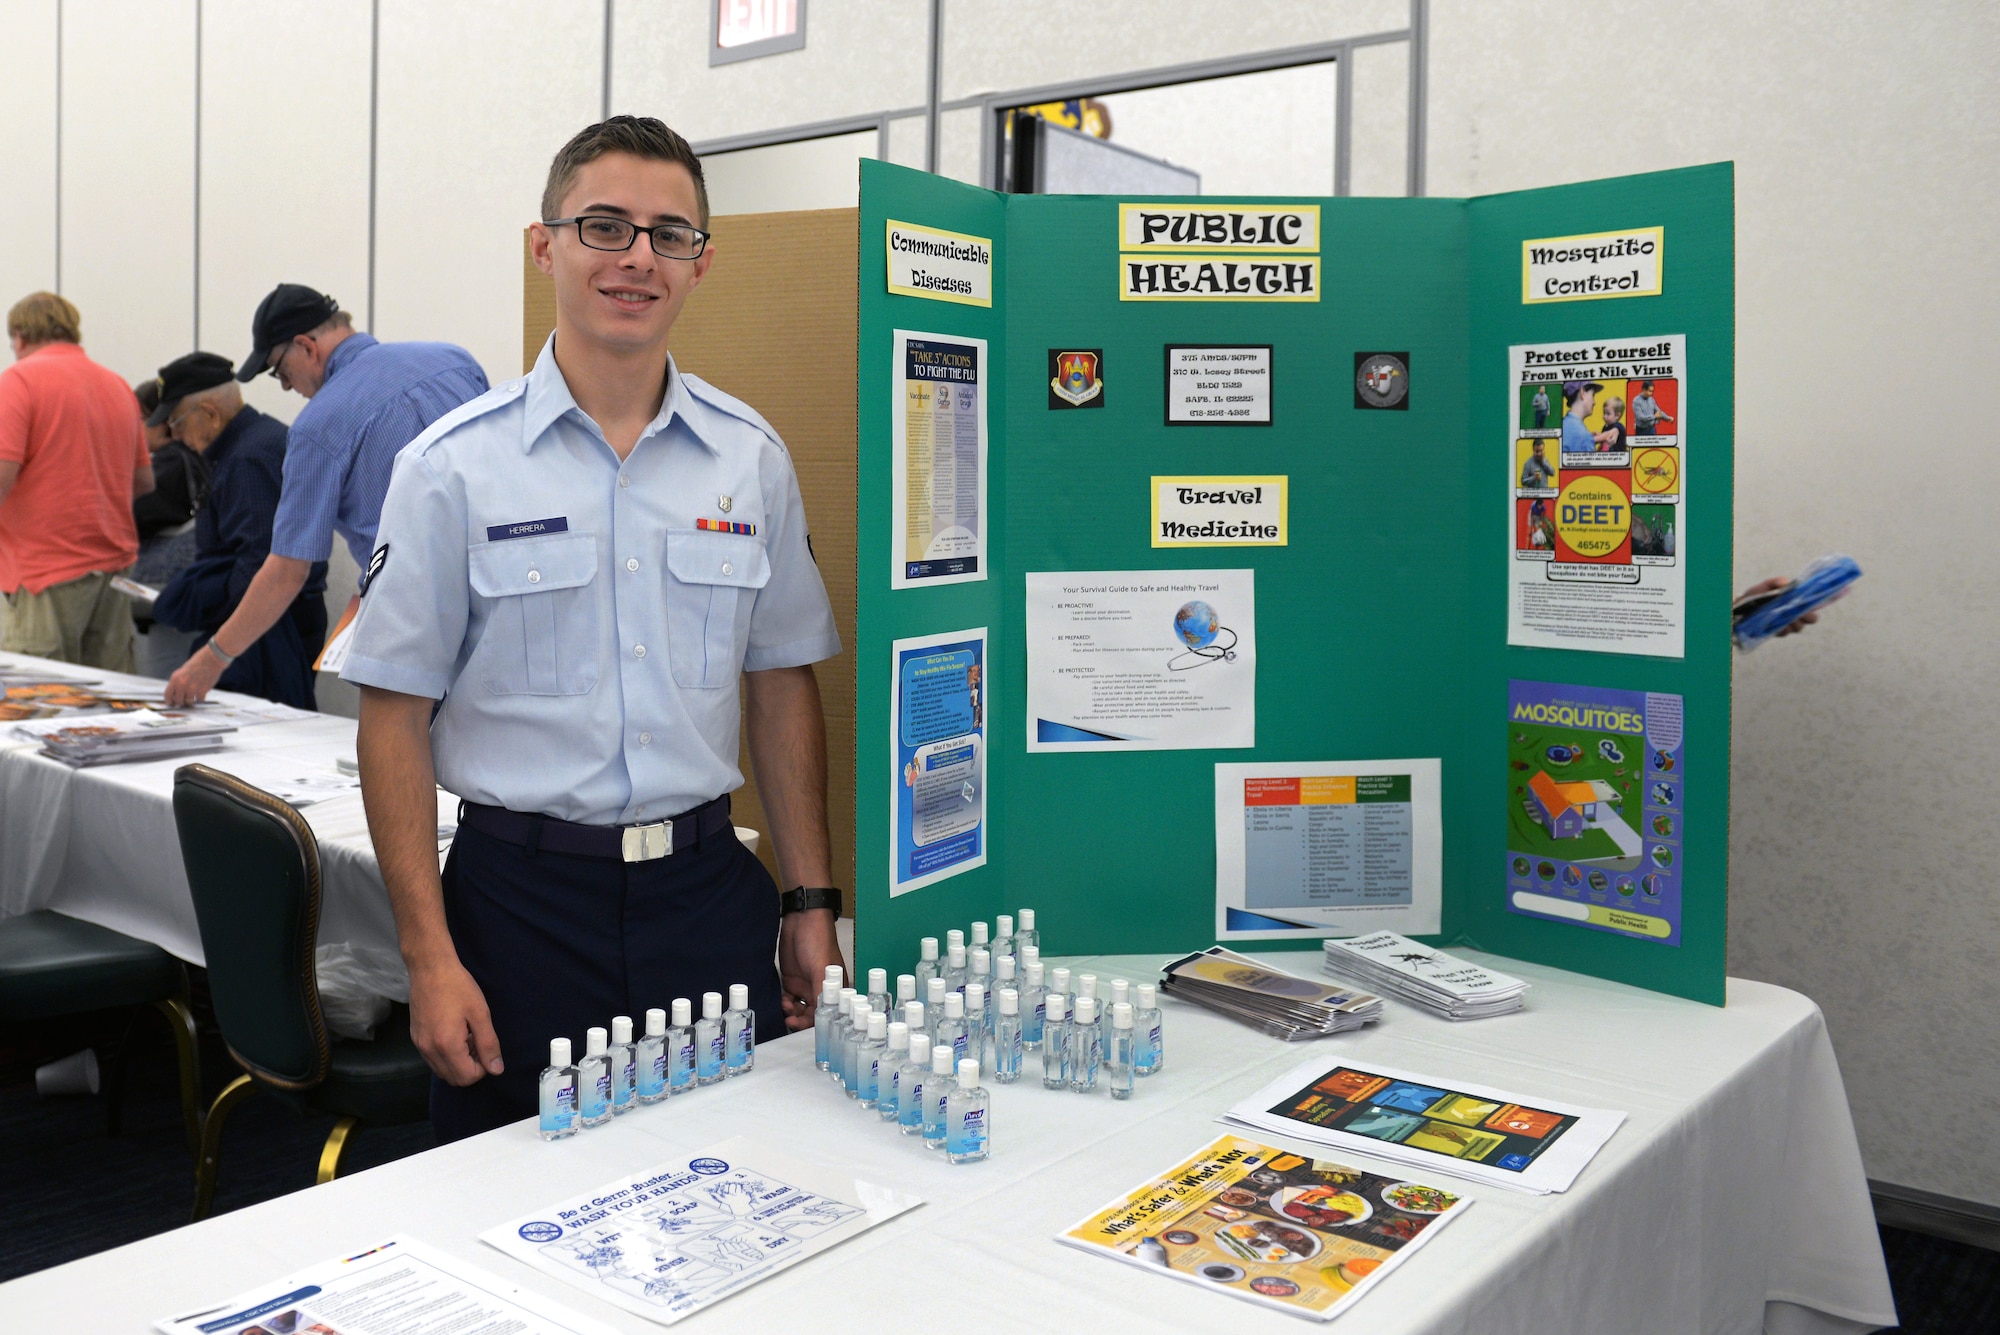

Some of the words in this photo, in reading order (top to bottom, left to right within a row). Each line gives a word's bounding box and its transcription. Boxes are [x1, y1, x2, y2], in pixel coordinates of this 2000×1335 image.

[1140, 212, 1303, 245] PUBLIC
[891, 231, 989, 265] Communicable
[1530, 238, 1655, 265] Mosquito
[911, 268, 972, 294] Diseases
[1127, 262, 1314, 294] HEALTH
[1545, 270, 1640, 295] Control
[943, 354, 971, 367] ACTIONS
[1525, 349, 1589, 364] Protect
[1593, 343, 1671, 360] Yourself
[914, 365, 926, 377] TO
[927, 366, 948, 378] FIGHT
[948, 368, 962, 380] THE
[963, 369, 976, 381] FLU
[1205, 368, 1231, 376] Losey
[1521, 370, 1558, 382] From
[1562, 367, 1595, 379] West
[1599, 365, 1628, 377] Nile
[1632, 364, 1673, 376] Virus
[909, 392, 930, 400] Vaccinate
[1176, 487, 1262, 505] Travel
[1568, 491, 1612, 501] Contains
[1562, 504, 1624, 525] DEET
[508, 523, 546, 536] HERRERA
[1160, 520, 1278, 539] Medicine
[1577, 540, 1611, 551] 465475
[1108, 585, 1128, 593] Guide
[1171, 585, 1197, 593] Healthy
[1513, 702, 1644, 733] MOSQUITOES
[1358, 782, 1379, 790] Practice
[1609, 916, 1627, 926] Public
[1628, 920, 1648, 930] Health
[1360, 940, 1399, 950] Control
[681, 1045, 694, 1055] Purell
[712, 1037, 725, 1047] Purell
[597, 1075, 611, 1087] Purell
[558, 1087, 575, 1098] Purell
[965, 1111, 983, 1120] Purell
[1216, 1149, 1247, 1165] Not
[1178, 1164, 1225, 1187] What's
[760, 1186, 793, 1201] WASH
[1168, 1186, 1190, 1196] &
[564, 1209, 611, 1229] WASH
[609, 1193, 652, 1212] YOUR
[649, 1173, 702, 1198] HANDS!
[669, 1201, 700, 1216] SOAP
[1139, 1193, 1175, 1213] Safer
[557, 1209, 578, 1220] Be
[580, 1204, 592, 1212] a
[1100, 1212, 1147, 1235] What's
[596, 1232, 623, 1245] WET
[765, 1236, 789, 1249] DRY
[654, 1256, 688, 1273] RINSE
[244, 1309, 260, 1318] CDC
[258, 1302, 273, 1313] Fact
[272, 1296, 294, 1307] Sheet
